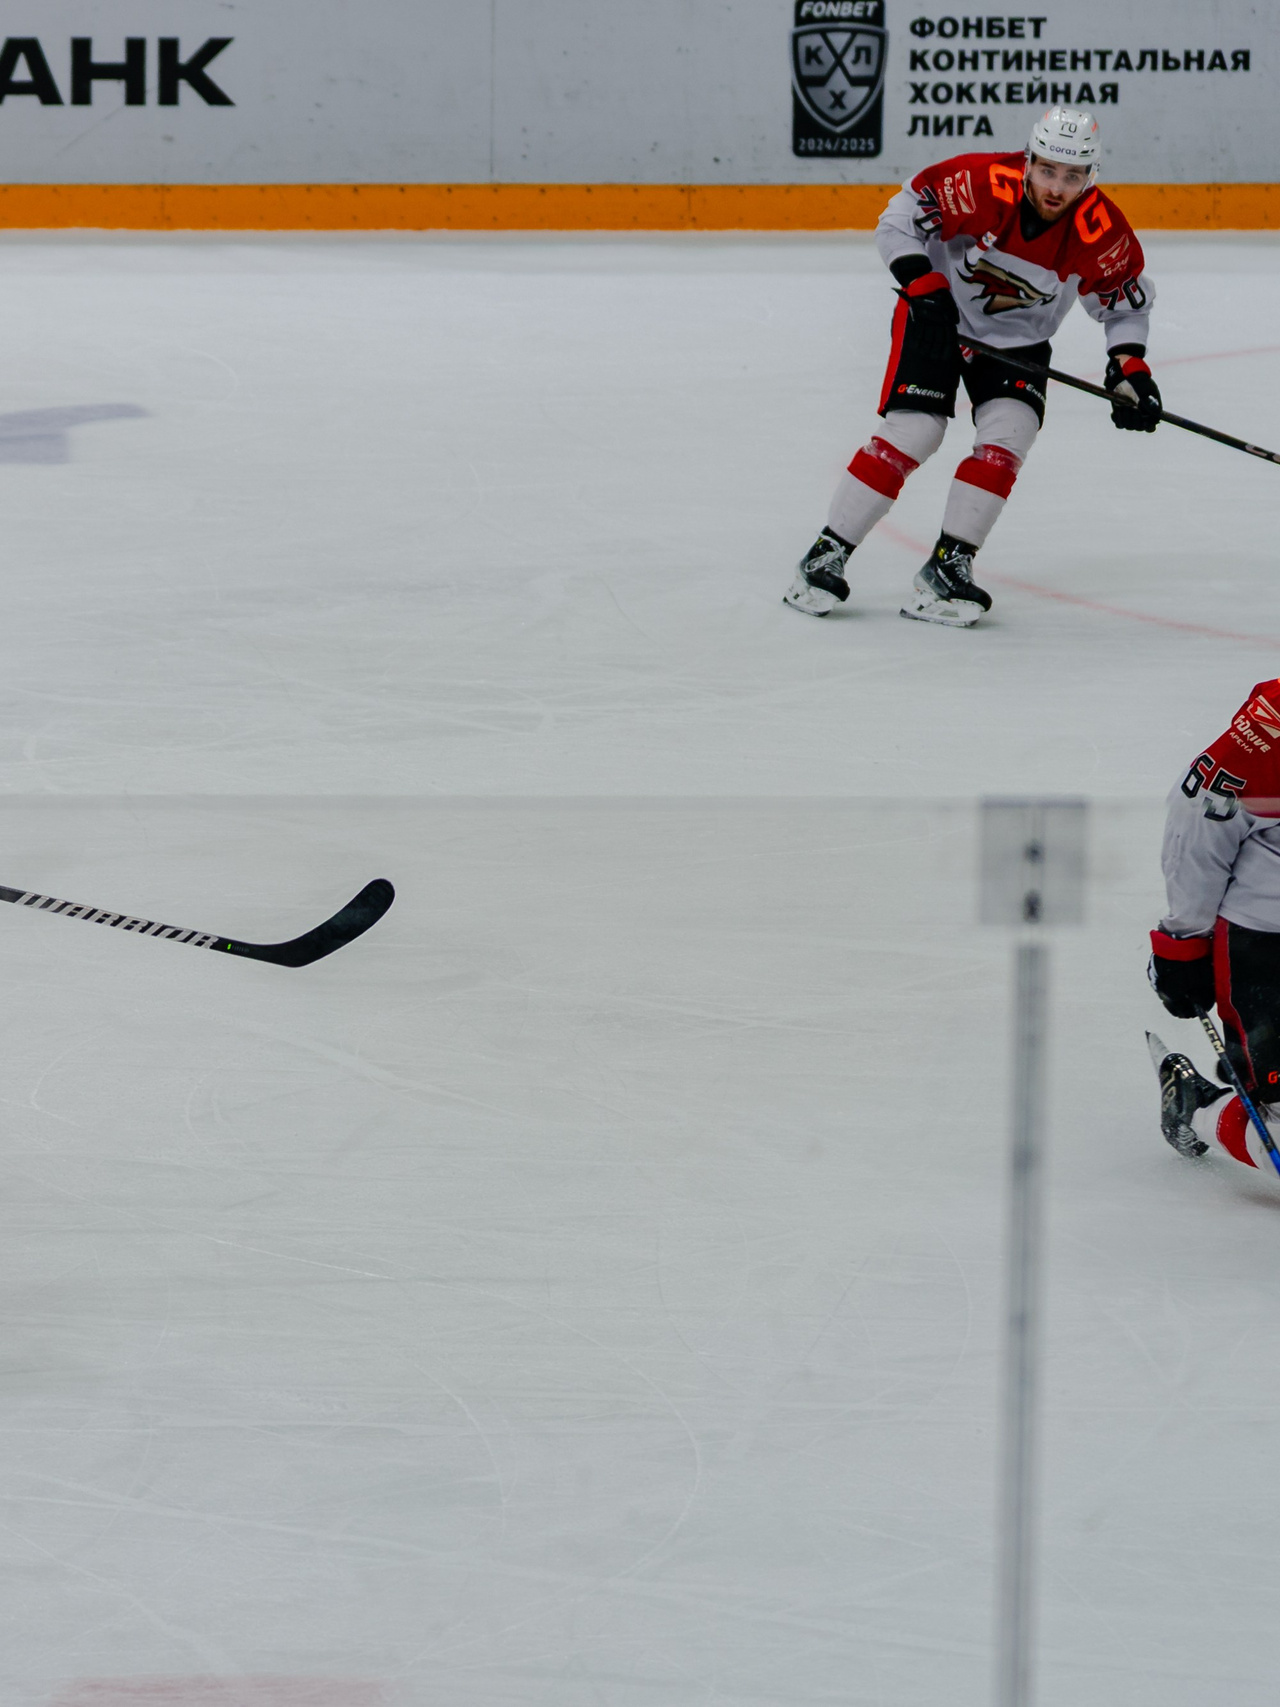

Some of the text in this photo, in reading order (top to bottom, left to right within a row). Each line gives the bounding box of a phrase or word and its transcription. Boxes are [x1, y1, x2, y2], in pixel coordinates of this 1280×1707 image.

[801, 1, 878, 17] FONBET
[909, 16, 1047, 38] ФОНБЕТ
[909, 49, 1251, 71] КОНТИНЕНТАЛЬНАЯ
[909, 76, 1119, 104] ХОККЕЙНАЯ
[907, 115, 994, 137] ЛИГА
[799, 137, 875, 150] 2024/2025
[1097, 276, 1147, 311] 70
[1181, 753, 1248, 822] 65
[14, 892, 220, 949] WARRIOR
